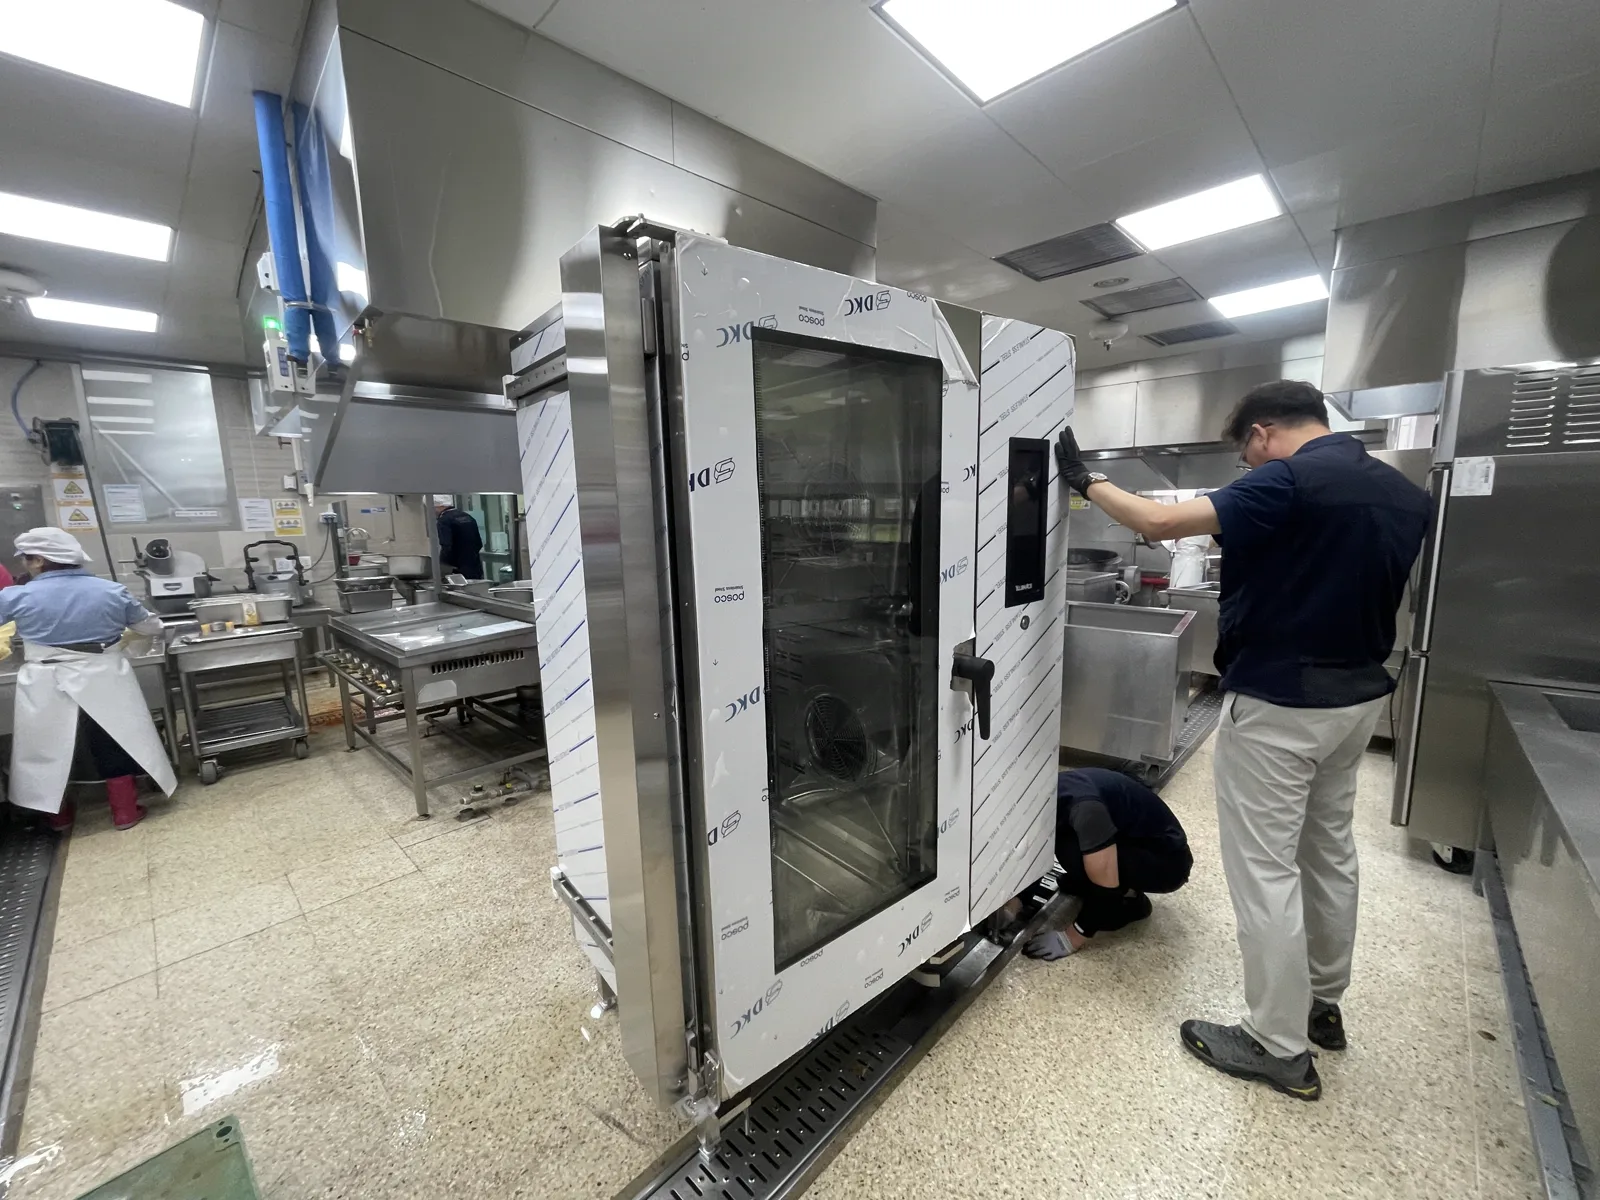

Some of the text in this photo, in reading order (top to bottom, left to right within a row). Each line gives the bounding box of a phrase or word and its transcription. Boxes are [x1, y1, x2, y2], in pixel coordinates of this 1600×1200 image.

[844, 295, 873, 316] DKC
[798, 314, 824, 326] posco
[940, 564, 956, 584] DK
[714, 591, 744, 603] posco
[725, 686, 760, 722] DKC
[721, 920, 749, 940] posco
[898, 925, 920, 958] DKC
[730, 998, 762, 1039] DKC
